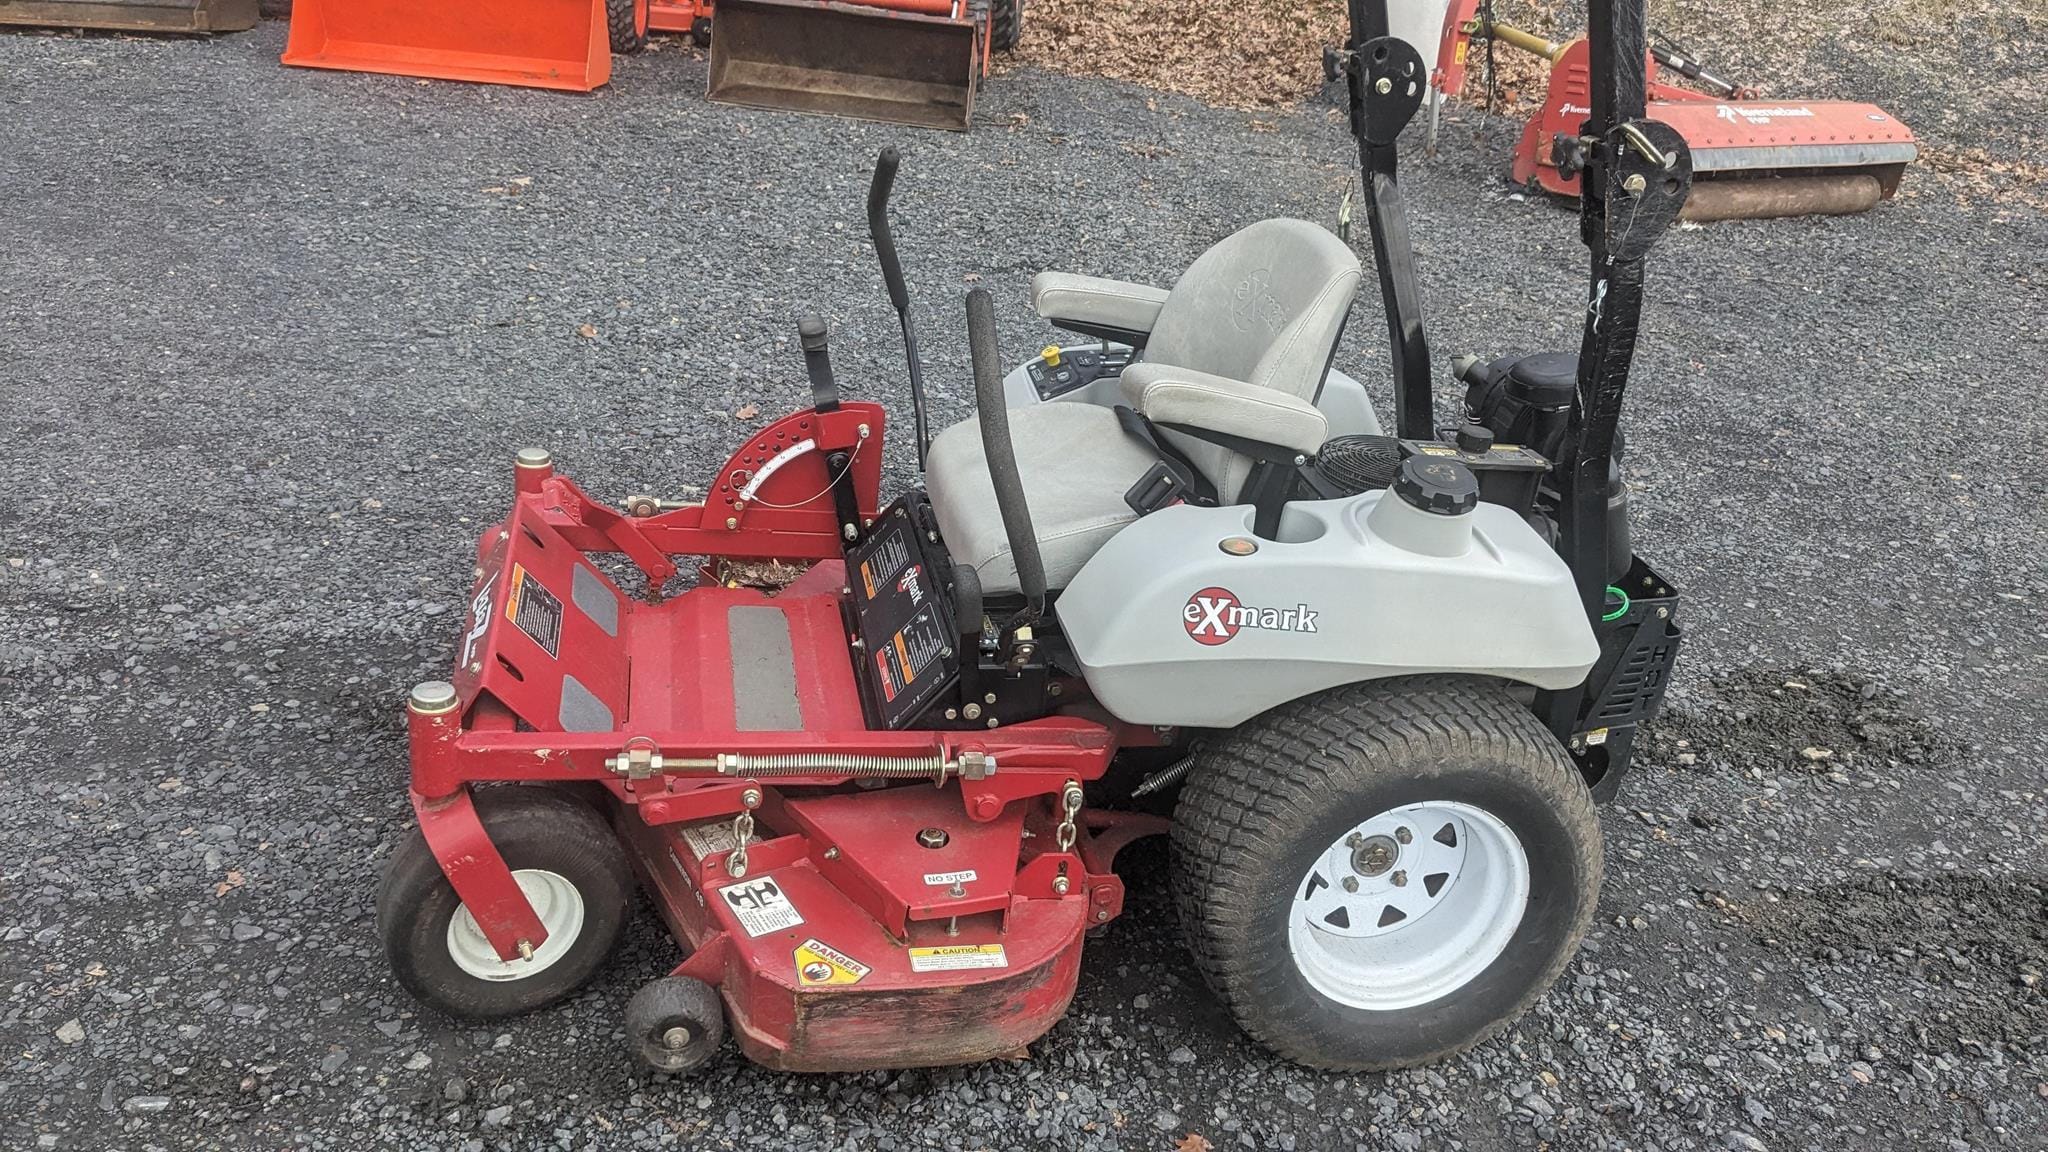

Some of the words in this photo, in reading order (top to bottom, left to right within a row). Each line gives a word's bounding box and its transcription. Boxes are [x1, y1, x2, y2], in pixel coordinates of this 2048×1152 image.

[1183, 596, 1319, 637] eXmark
[946, 872, 973, 881] STEP
[809, 942, 863, 973] DANGER
[942, 947, 980, 955] CAUTION
